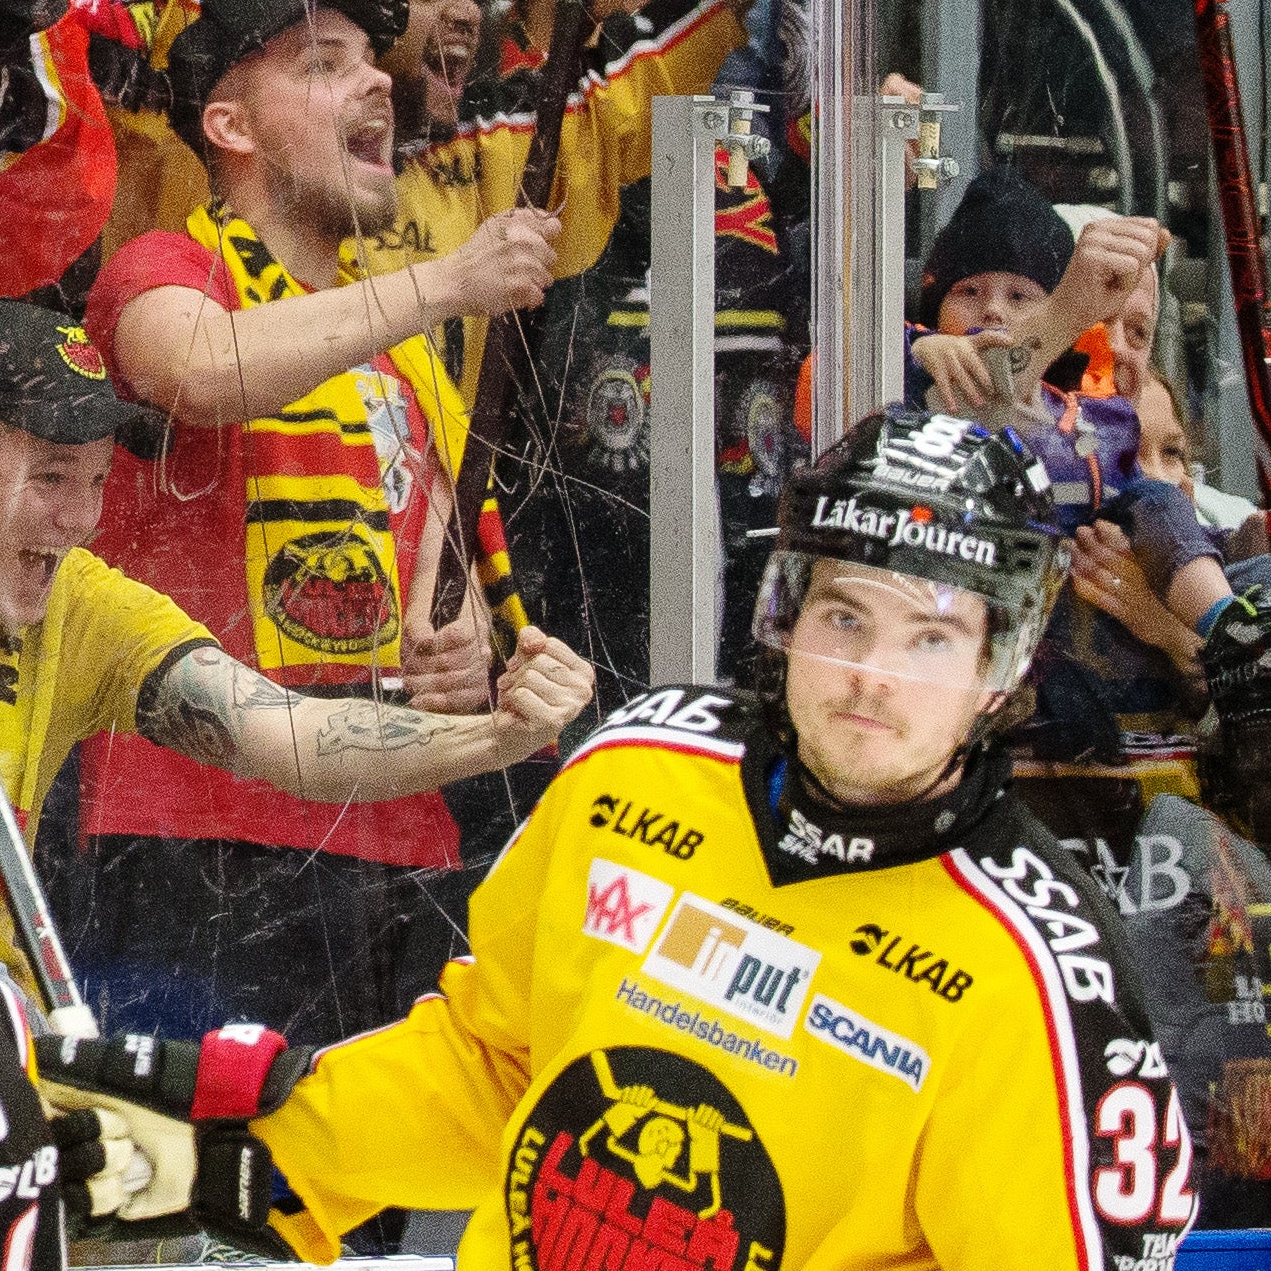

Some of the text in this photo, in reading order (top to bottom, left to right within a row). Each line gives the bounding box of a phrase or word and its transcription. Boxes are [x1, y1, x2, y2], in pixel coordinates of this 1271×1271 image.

[811, 495, 997, 567] LäkarJouren
[616, 801, 706, 860] LKAB
[980, 846, 1114, 1007] SSAB
[876, 936, 975, 1004] LKAB
[616, 978, 798, 1079] Handelsbanken
[807, 1000, 925, 1086] SCANIA
[1094, 1082, 1196, 1226] 32
